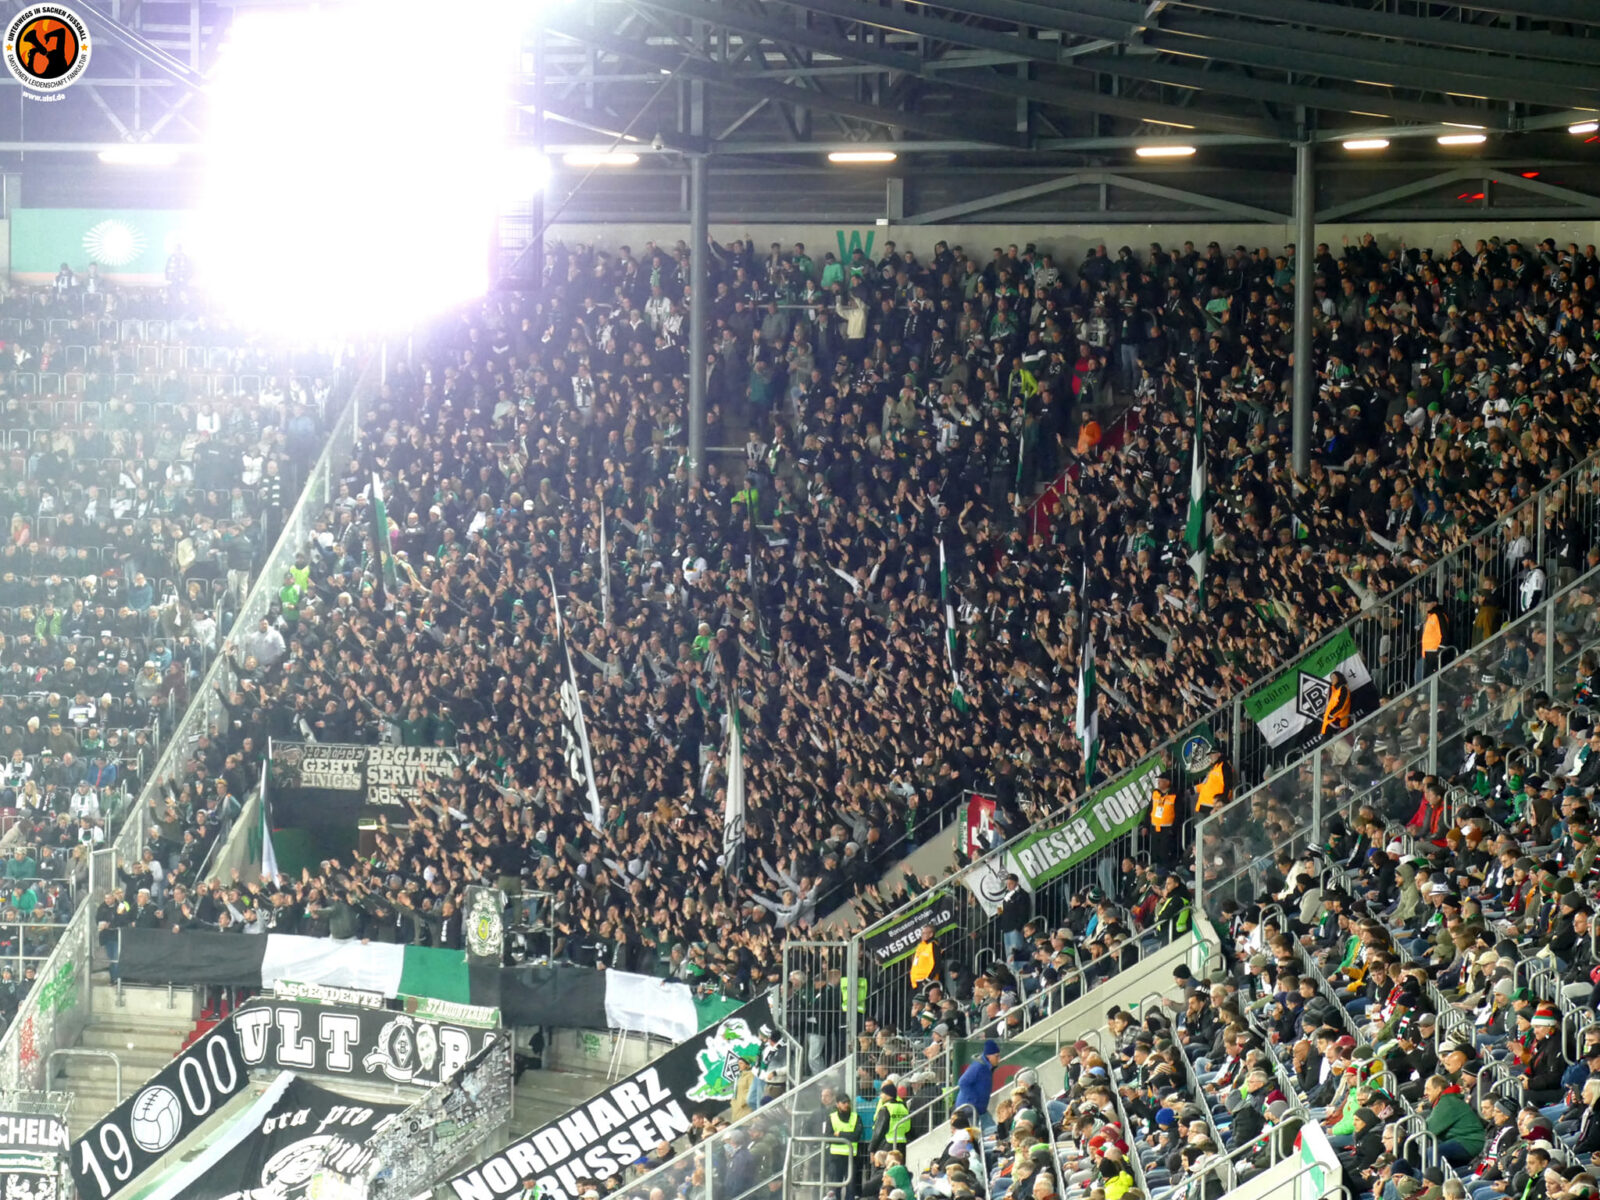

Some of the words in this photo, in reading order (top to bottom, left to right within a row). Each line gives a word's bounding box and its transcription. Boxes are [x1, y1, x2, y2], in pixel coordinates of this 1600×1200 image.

[836, 230, 875, 265] W
[1273, 718, 1289, 734] 20
[301, 772, 361, 790] EINIGES
[303, 759, 358, 774] GEHT
[1018, 817, 1096, 879] RIESER
[876, 910, 951, 959] WESTERLD
[262, 1107, 312, 1135] ora
[313, 1105, 374, 1135] pro
[451, 1066, 672, 1200] NORDHARZ
